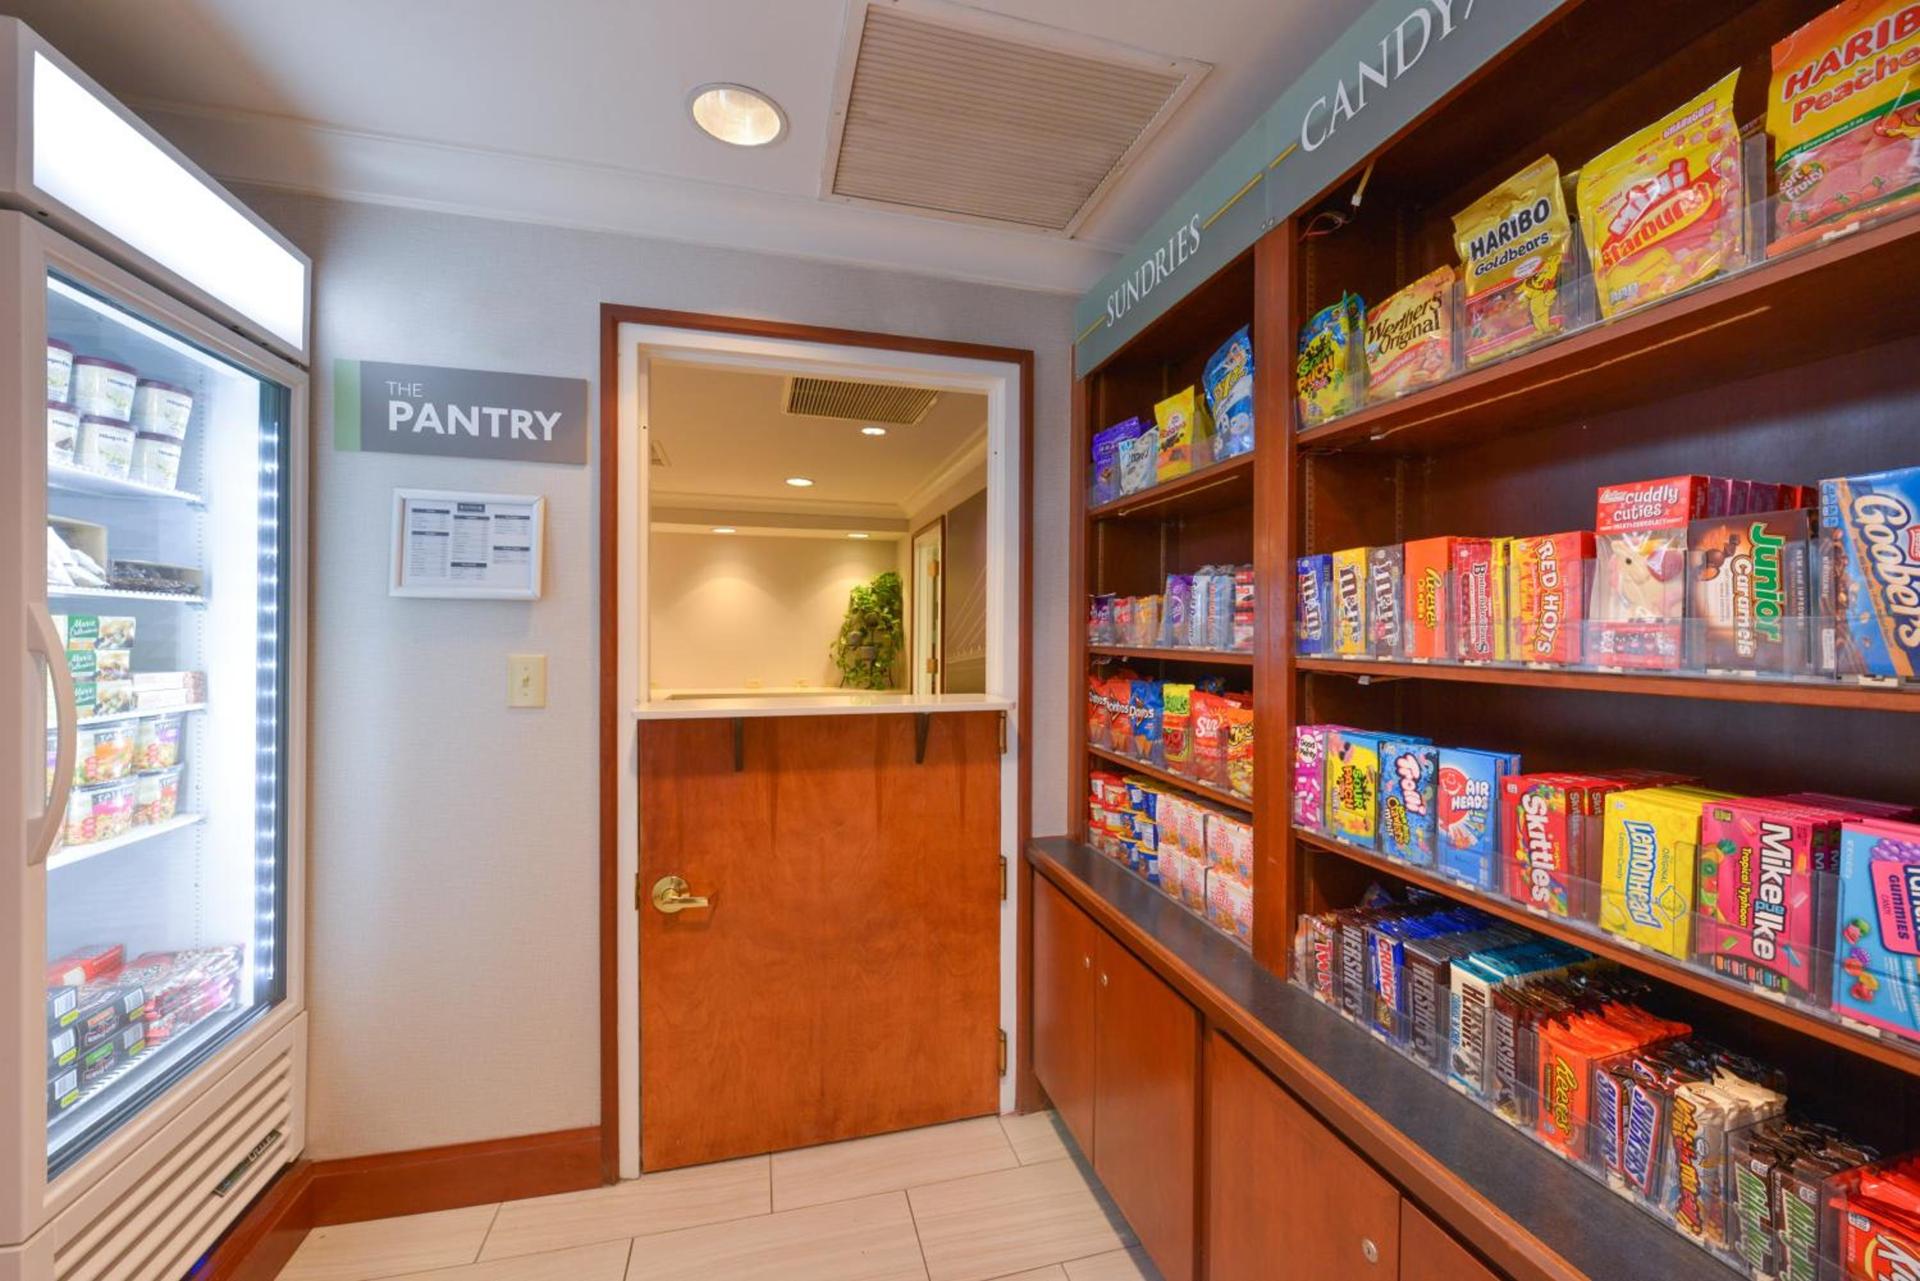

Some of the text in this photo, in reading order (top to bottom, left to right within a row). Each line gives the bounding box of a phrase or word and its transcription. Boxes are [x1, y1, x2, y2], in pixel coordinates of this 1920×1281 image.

[1107, 213, 1200, 327] SUNDRIES
[1470, 198, 1551, 261] HARIBO
[1474, 231, 1549, 277] Goldbears
[1379, 309, 1441, 354] Original
[385, 381, 423, 397] THE
[388, 400, 563, 441] PANTRY
[1614, 503, 1662, 522] cuties
[1625, 484, 1679, 505] cuddly
[1535, 541, 1560, 656] RED HOTS
[1732, 556, 1754, 658] Caramels
[1751, 523, 1784, 641] Junior
[1854, 494, 1920, 648] Goobers
[1353, 768, 1364, 809] SOUR
[1451, 796, 1489, 811] HEADS
[1466, 780, 1489, 797] AIR
[1521, 793, 1554, 903] Skittles
[1738, 847, 1752, 928] Tropical Typhoon
[1751, 822, 1793, 961] Mike and Ike
[1888, 875, 1910, 940] GUMMIES
[1343, 925, 1363, 1015] HERSHEY'S
[1378, 939, 1396, 1007] CRUNCH
[1413, 963, 1438, 1058] HERSHEY'S
[1462, 983, 1486, 1082] HERSHEY'S
[1596, 1075, 1619, 1165] SNICKERS
[1624, 1090, 1656, 1186] SNICKERS
